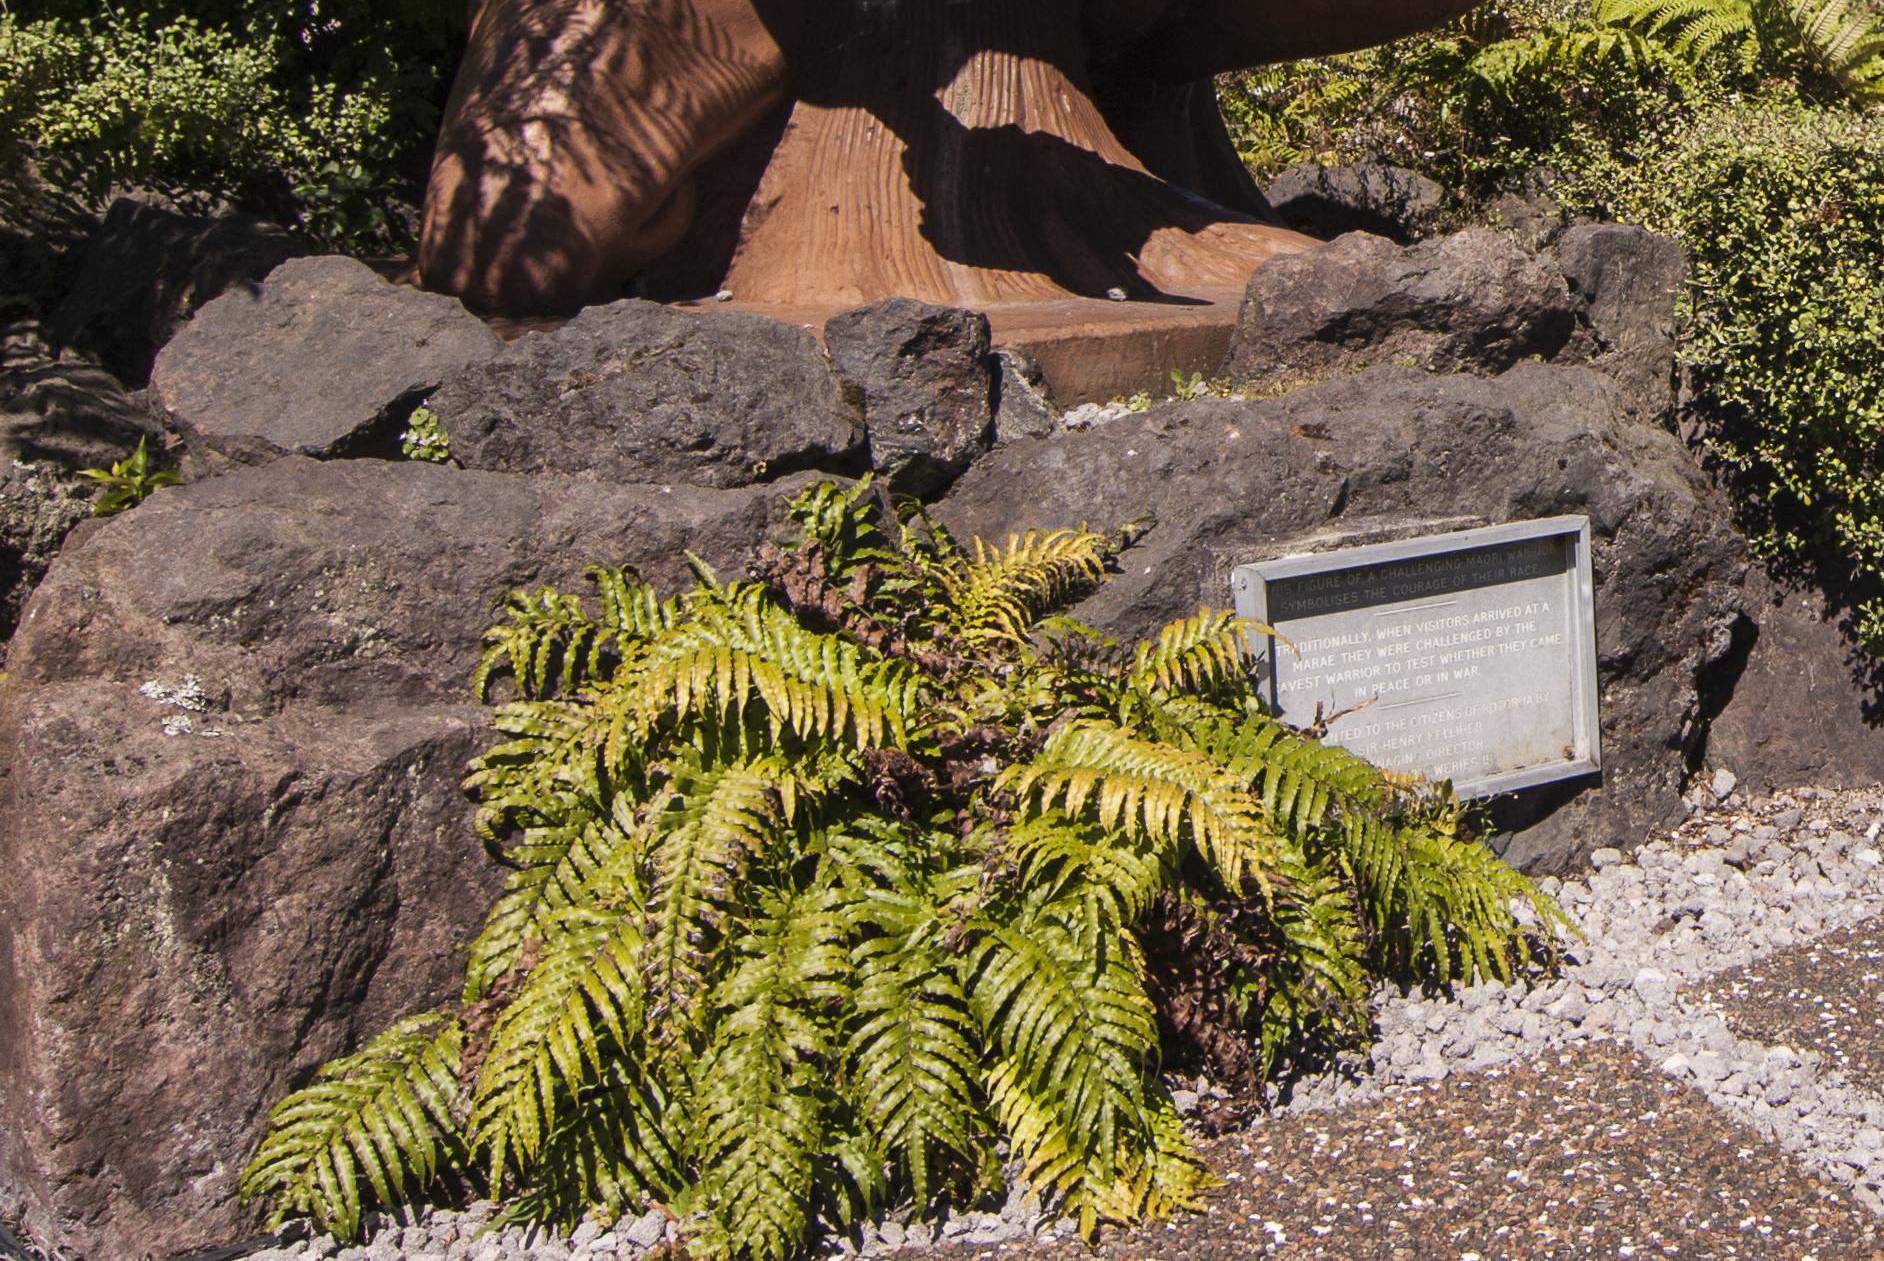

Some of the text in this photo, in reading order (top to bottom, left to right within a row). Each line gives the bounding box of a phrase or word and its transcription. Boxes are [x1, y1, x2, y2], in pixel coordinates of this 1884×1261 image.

[1280, 591, 1359, 614] SYMBOLISES
[1364, 587, 1387, 600] THE
[1393, 578, 1447, 596] COURAGE
[1453, 575, 1466, 586] OF
[1472, 569, 1505, 583] THEIR
[1298, 576, 1340, 592] FIGURE
[1348, 573, 1362, 584] OF
[1368, 571, 1376, 581] A
[1381, 558, 1461, 581] CHALLENGING
[1467, 552, 1502, 567] MAORI
[1377, 624, 1411, 639] WHEN
[1416, 615, 1469, 633] VISITORS
[1473, 606, 1521, 623] ARRIVED
[1524, 604, 1539, 615] AT
[1542, 602, 1549, 612] A
[1292, 621, 1536, 672] MARAE THEY WERE CHALLENGED BY THE
[1327, 666, 1380, 684] WARRIOR
[1385, 662, 1401, 673] TO
[1407, 656, 1434, 670] TEST
[1440, 646, 1495, 664] WHETHER
[1498, 640, 1528, 654] THEY
[1530, 634, 1561, 648] CAME
[1354, 686, 1366, 697] IN
[1372, 678, 1410, 694] PEACE
[1416, 675, 1432, 686] OR
[1437, 671, 1449, 682] IN
[1366, 724, 1381, 736] TO
[1385, 719, 1406, 732] THE
[1411, 708, 1462, 727] CITIZENS
[1465, 705, 1480, 717] OF
[1537, 691, 1550, 703] BY
[1358, 742, 1377, 755] SIR
[1383, 732, 1423, 750] HENRY
[1426, 739, 1484, 759] DIRECTOR
